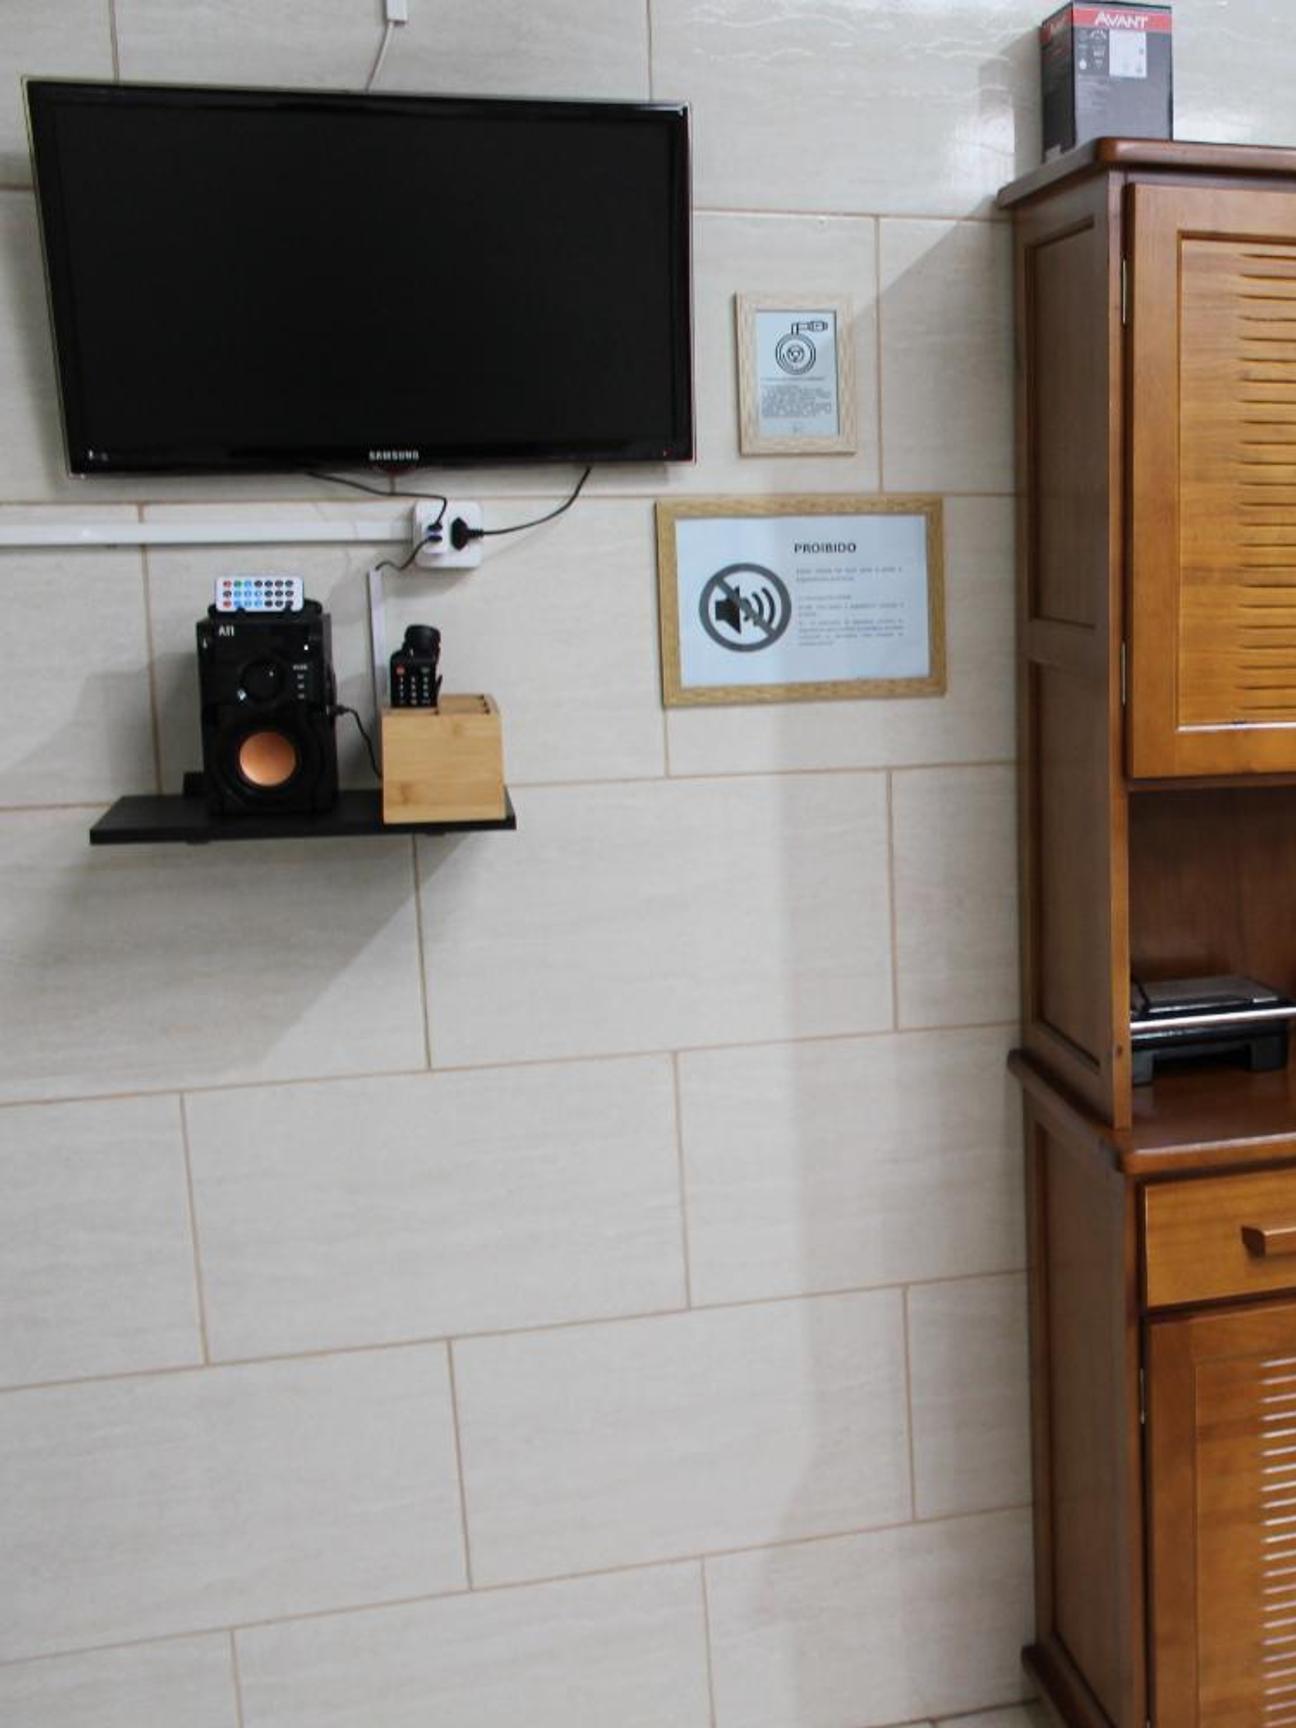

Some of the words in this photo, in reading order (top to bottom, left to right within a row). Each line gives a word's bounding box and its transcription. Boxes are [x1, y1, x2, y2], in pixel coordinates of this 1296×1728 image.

[1094, 11, 1149, 29] AVANT
[369, 449, 420, 461] SAMSUNG
[794, 542, 857, 553] PROIBIDO
